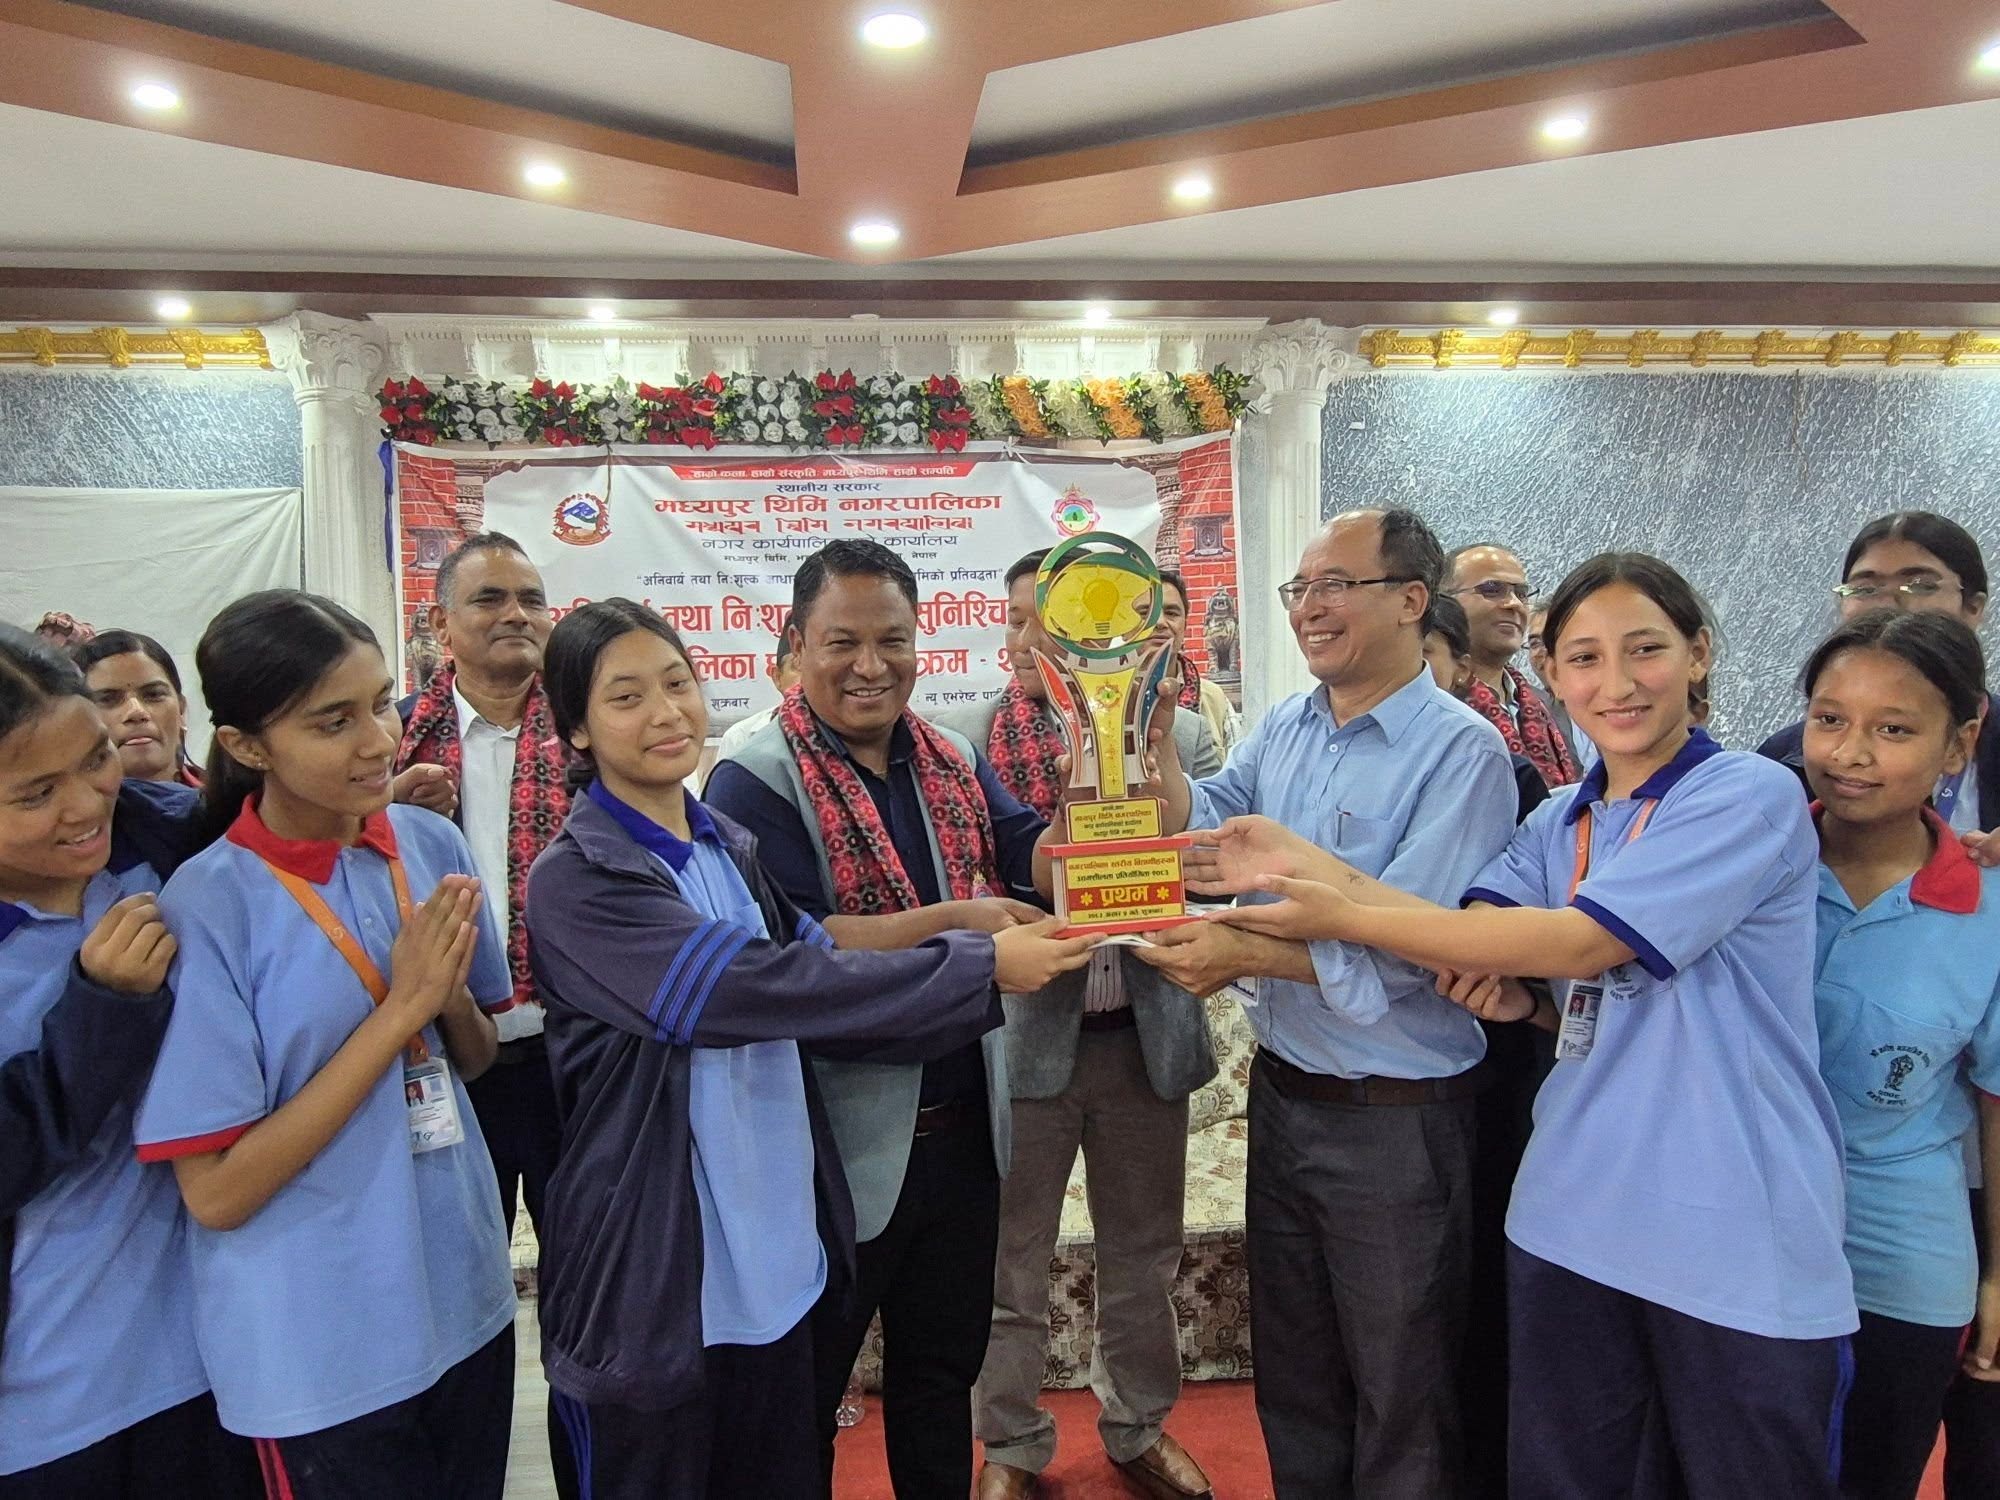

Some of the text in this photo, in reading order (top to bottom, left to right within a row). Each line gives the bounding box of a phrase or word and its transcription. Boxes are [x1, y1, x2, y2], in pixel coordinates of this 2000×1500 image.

[776, 482, 882, 493] स्थानीय सरकार
[655, 491, 1002, 518] मध्यपुर थिमि नगरपालिका
[701, 538, 745, 549] नगर
[883, 533, 958, 547] कार्यालय
[911, 551, 937, 560] नेपाल
[690, 575, 711, 585] तथा
[660, 605, 713, 632] तथा
[1100, 885, 1149, 907] प्रथम
